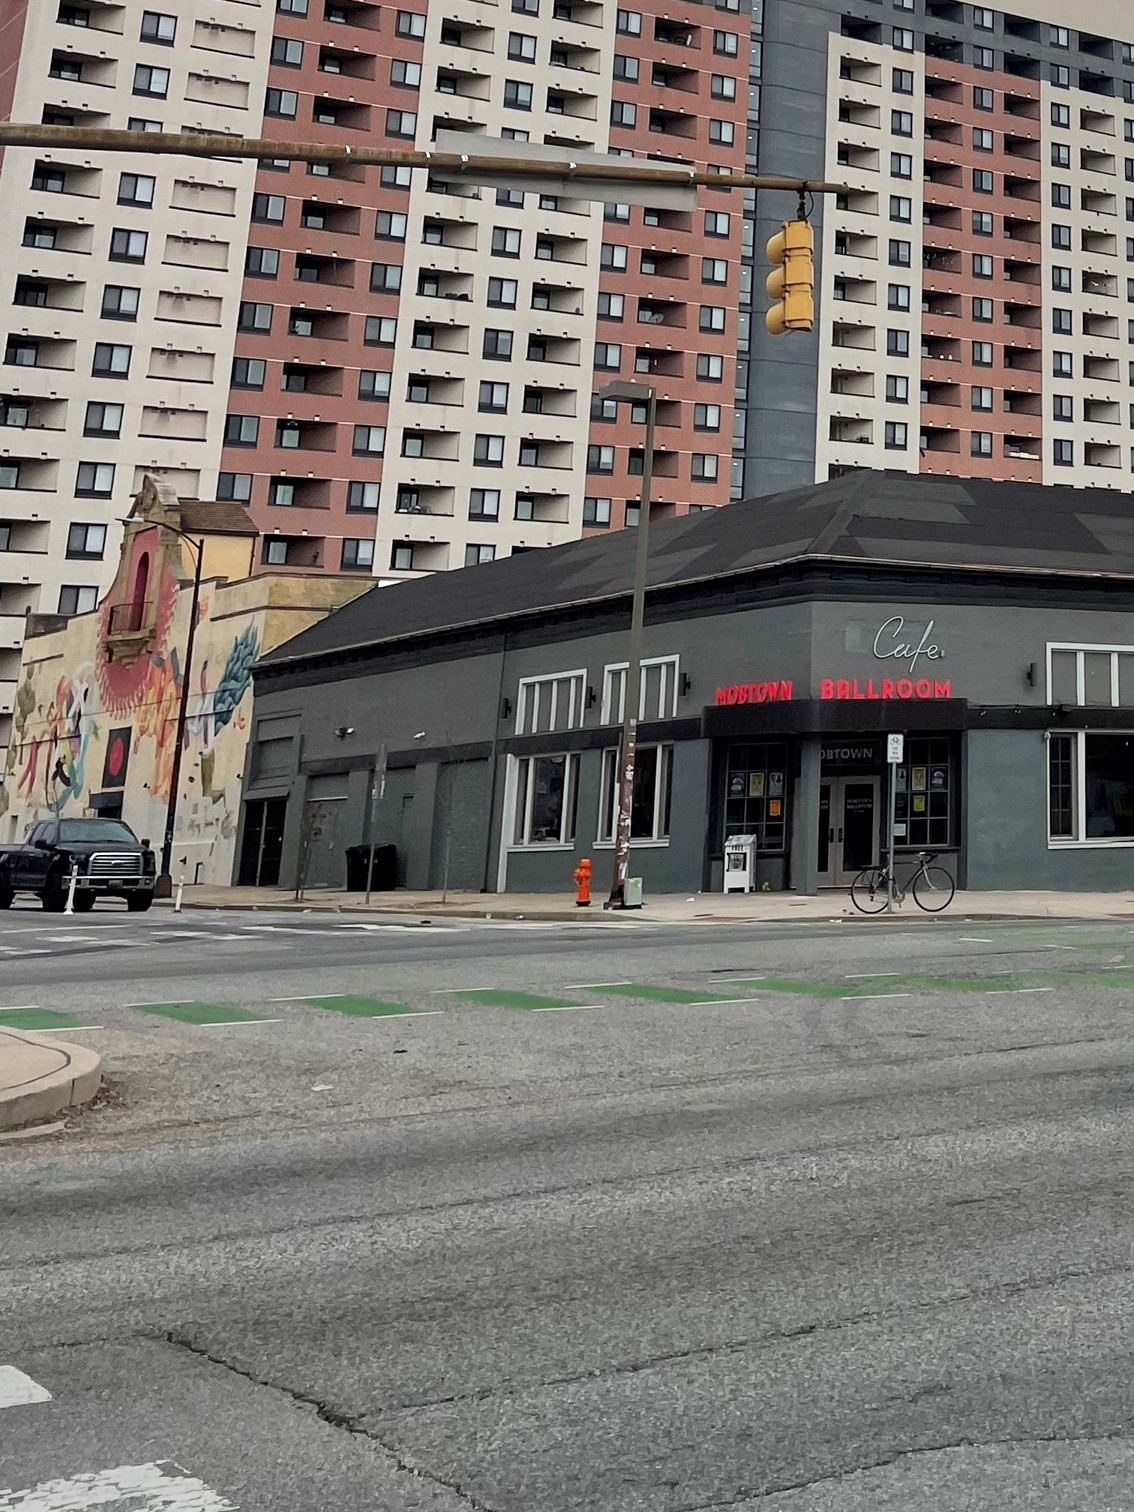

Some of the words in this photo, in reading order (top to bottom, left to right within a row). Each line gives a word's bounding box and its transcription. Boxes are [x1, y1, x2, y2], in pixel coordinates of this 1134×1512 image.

[872, 615, 940, 673] Cafe
[714, 679, 793, 706] MOBTOWN
[820, 678, 951, 700] BALLROOM
[820, 747, 873, 760] OBTOWN
